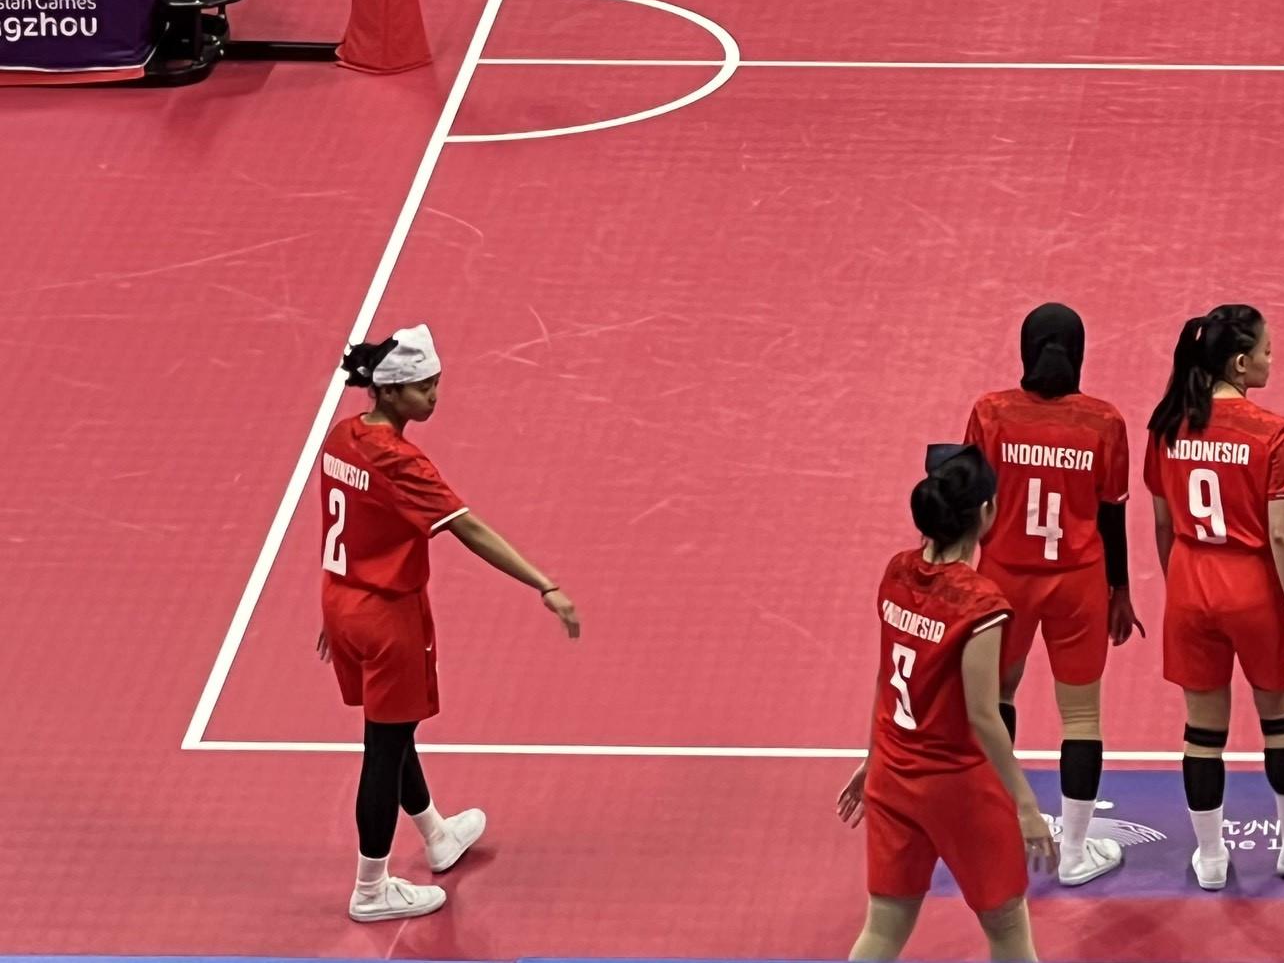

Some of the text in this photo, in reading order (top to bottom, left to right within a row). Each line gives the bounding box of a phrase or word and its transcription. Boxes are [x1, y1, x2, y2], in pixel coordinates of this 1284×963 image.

[1001, 442, 1094, 471] INDONESIA
[322, 487, 347, 577] 2
[1025, 477, 1063, 561] 4
[1188, 468, 1228, 545] 9
[889, 642, 918, 731] 5
